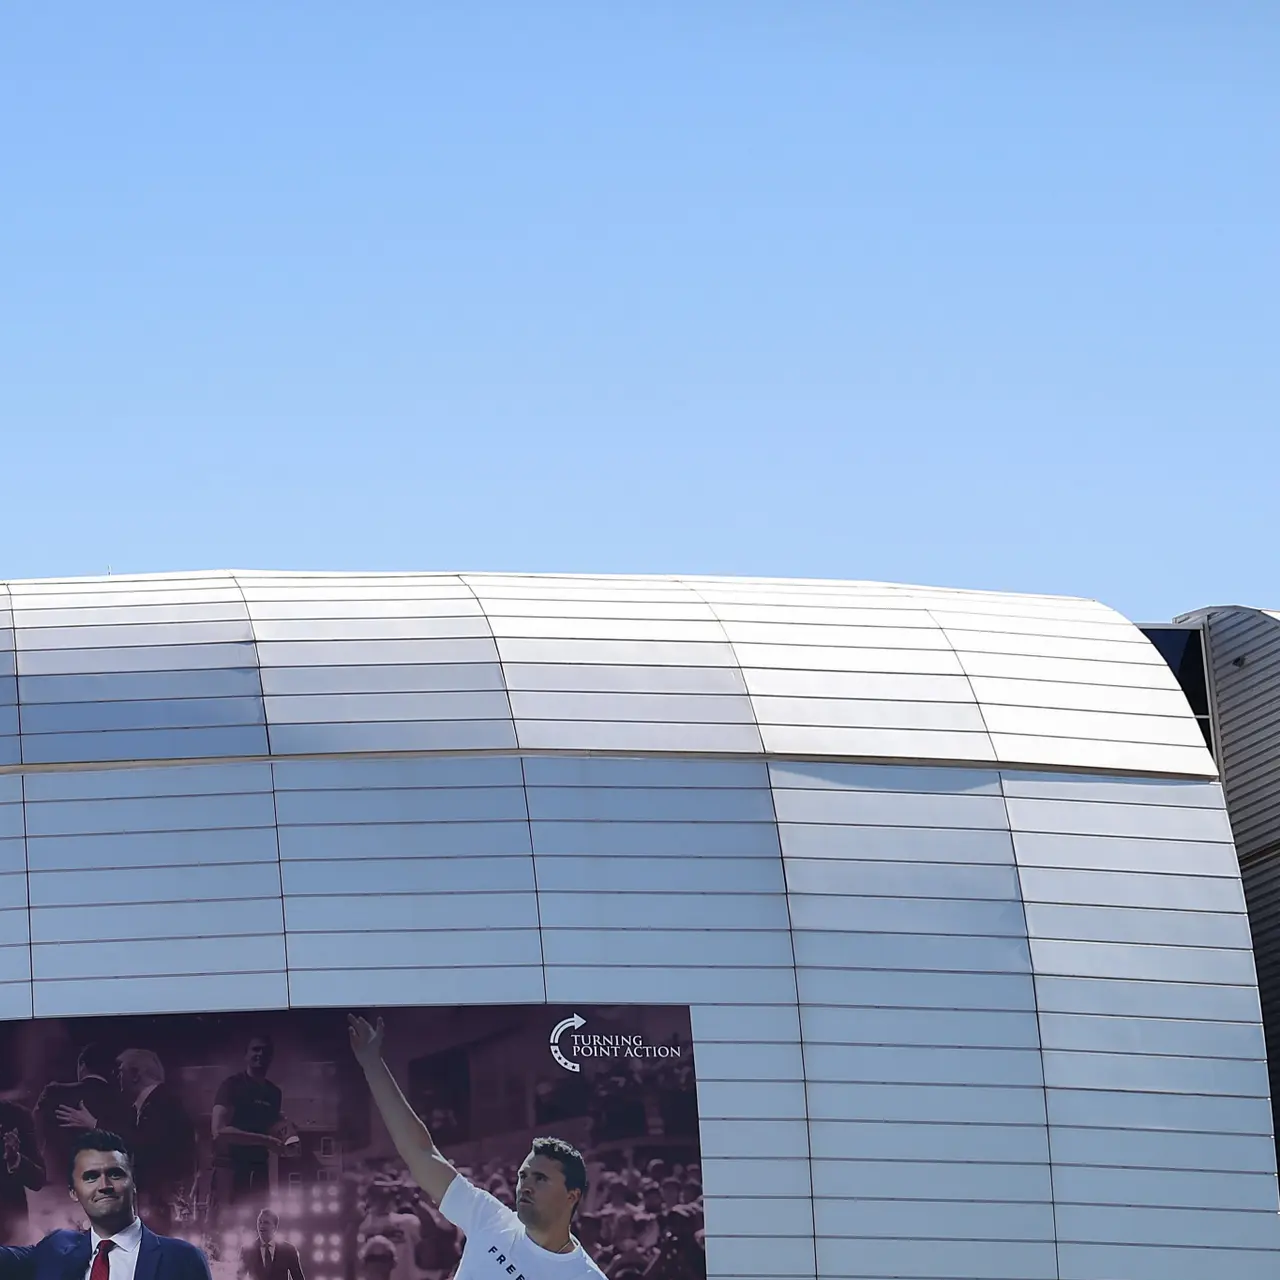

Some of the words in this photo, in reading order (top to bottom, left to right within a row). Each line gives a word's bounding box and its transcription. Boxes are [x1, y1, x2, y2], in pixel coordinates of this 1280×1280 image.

[571, 1034, 643, 1046] TURNING
[572, 1045, 621, 1057] POINT
[624, 1045, 681, 1058] ACTION
